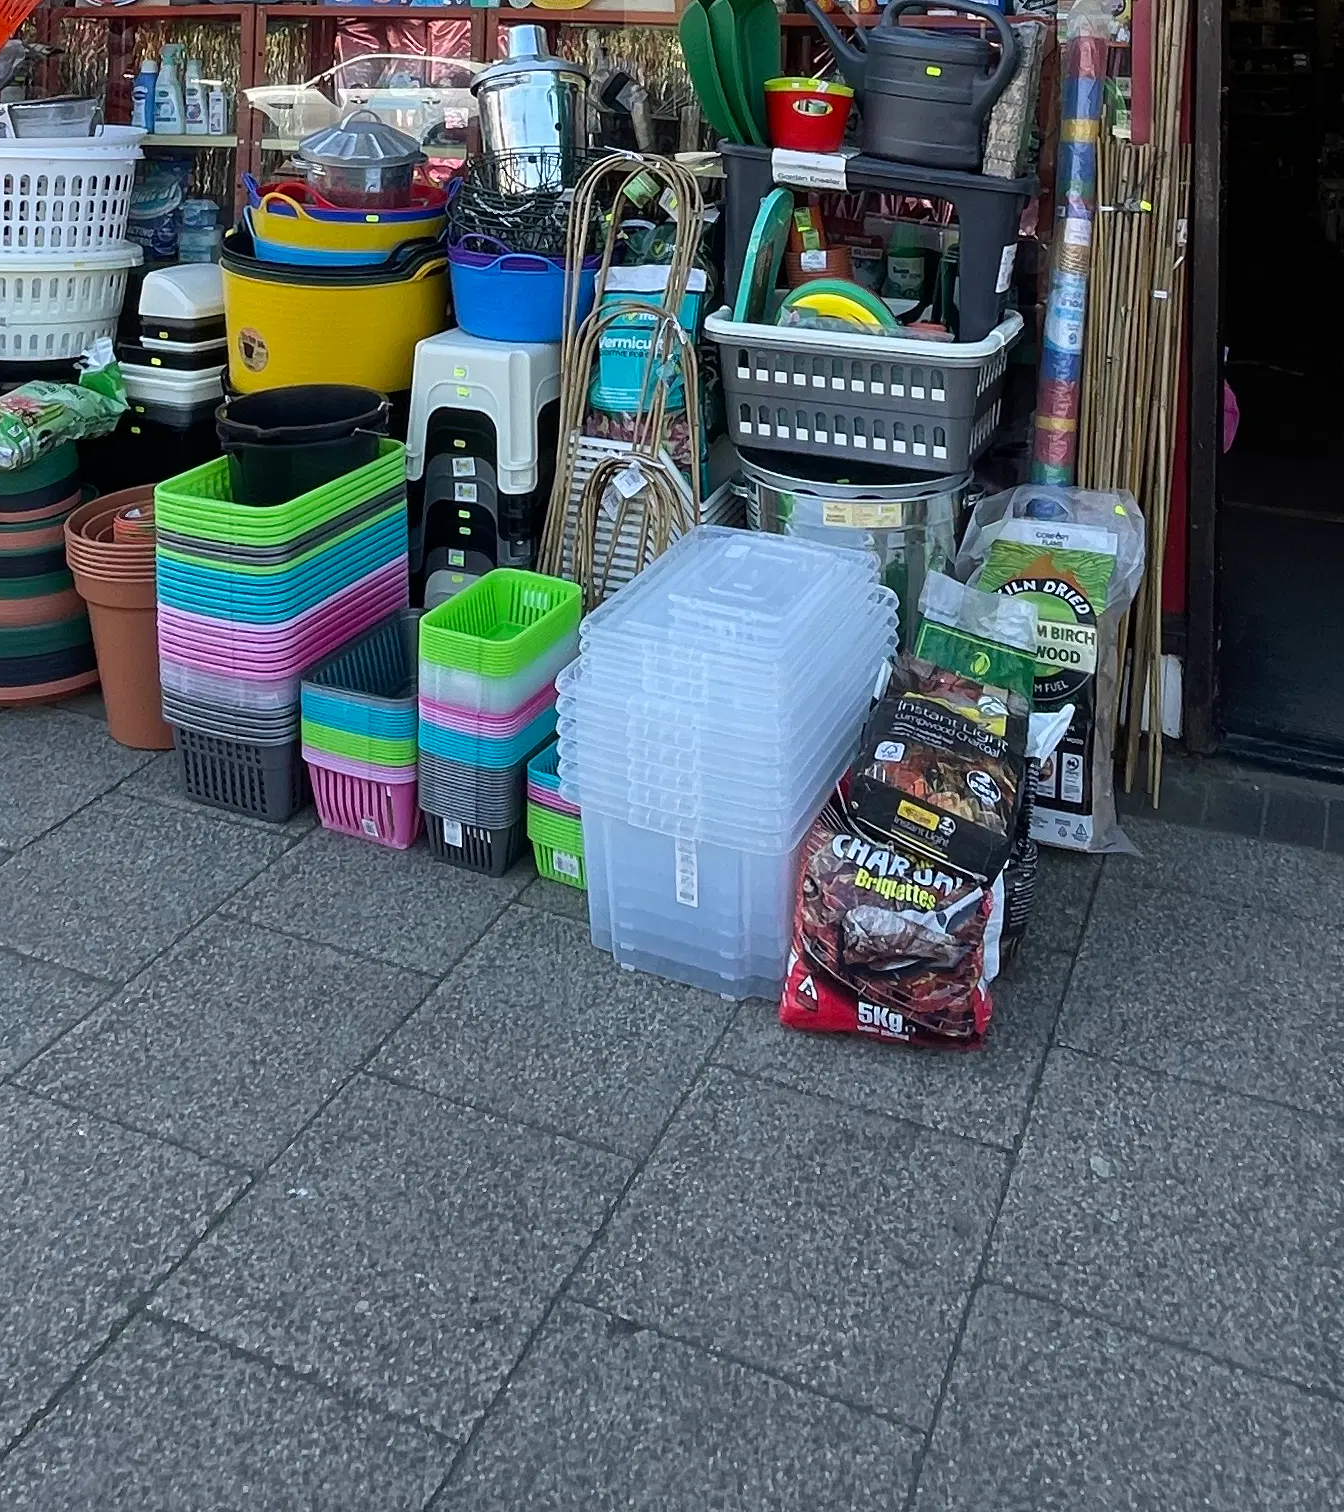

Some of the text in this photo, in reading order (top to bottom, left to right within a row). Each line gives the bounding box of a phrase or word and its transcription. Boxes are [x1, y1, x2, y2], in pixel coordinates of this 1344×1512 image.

[1042, 579, 1091, 616] DRIED
[1050, 625, 1096, 647] BIRCH
[1044, 680, 1070, 693] FUEL
[897, 699, 958, 729] Instant
[855, 869, 938, 910] Briquettes
[858, 1000, 905, 1032] 5Kg
